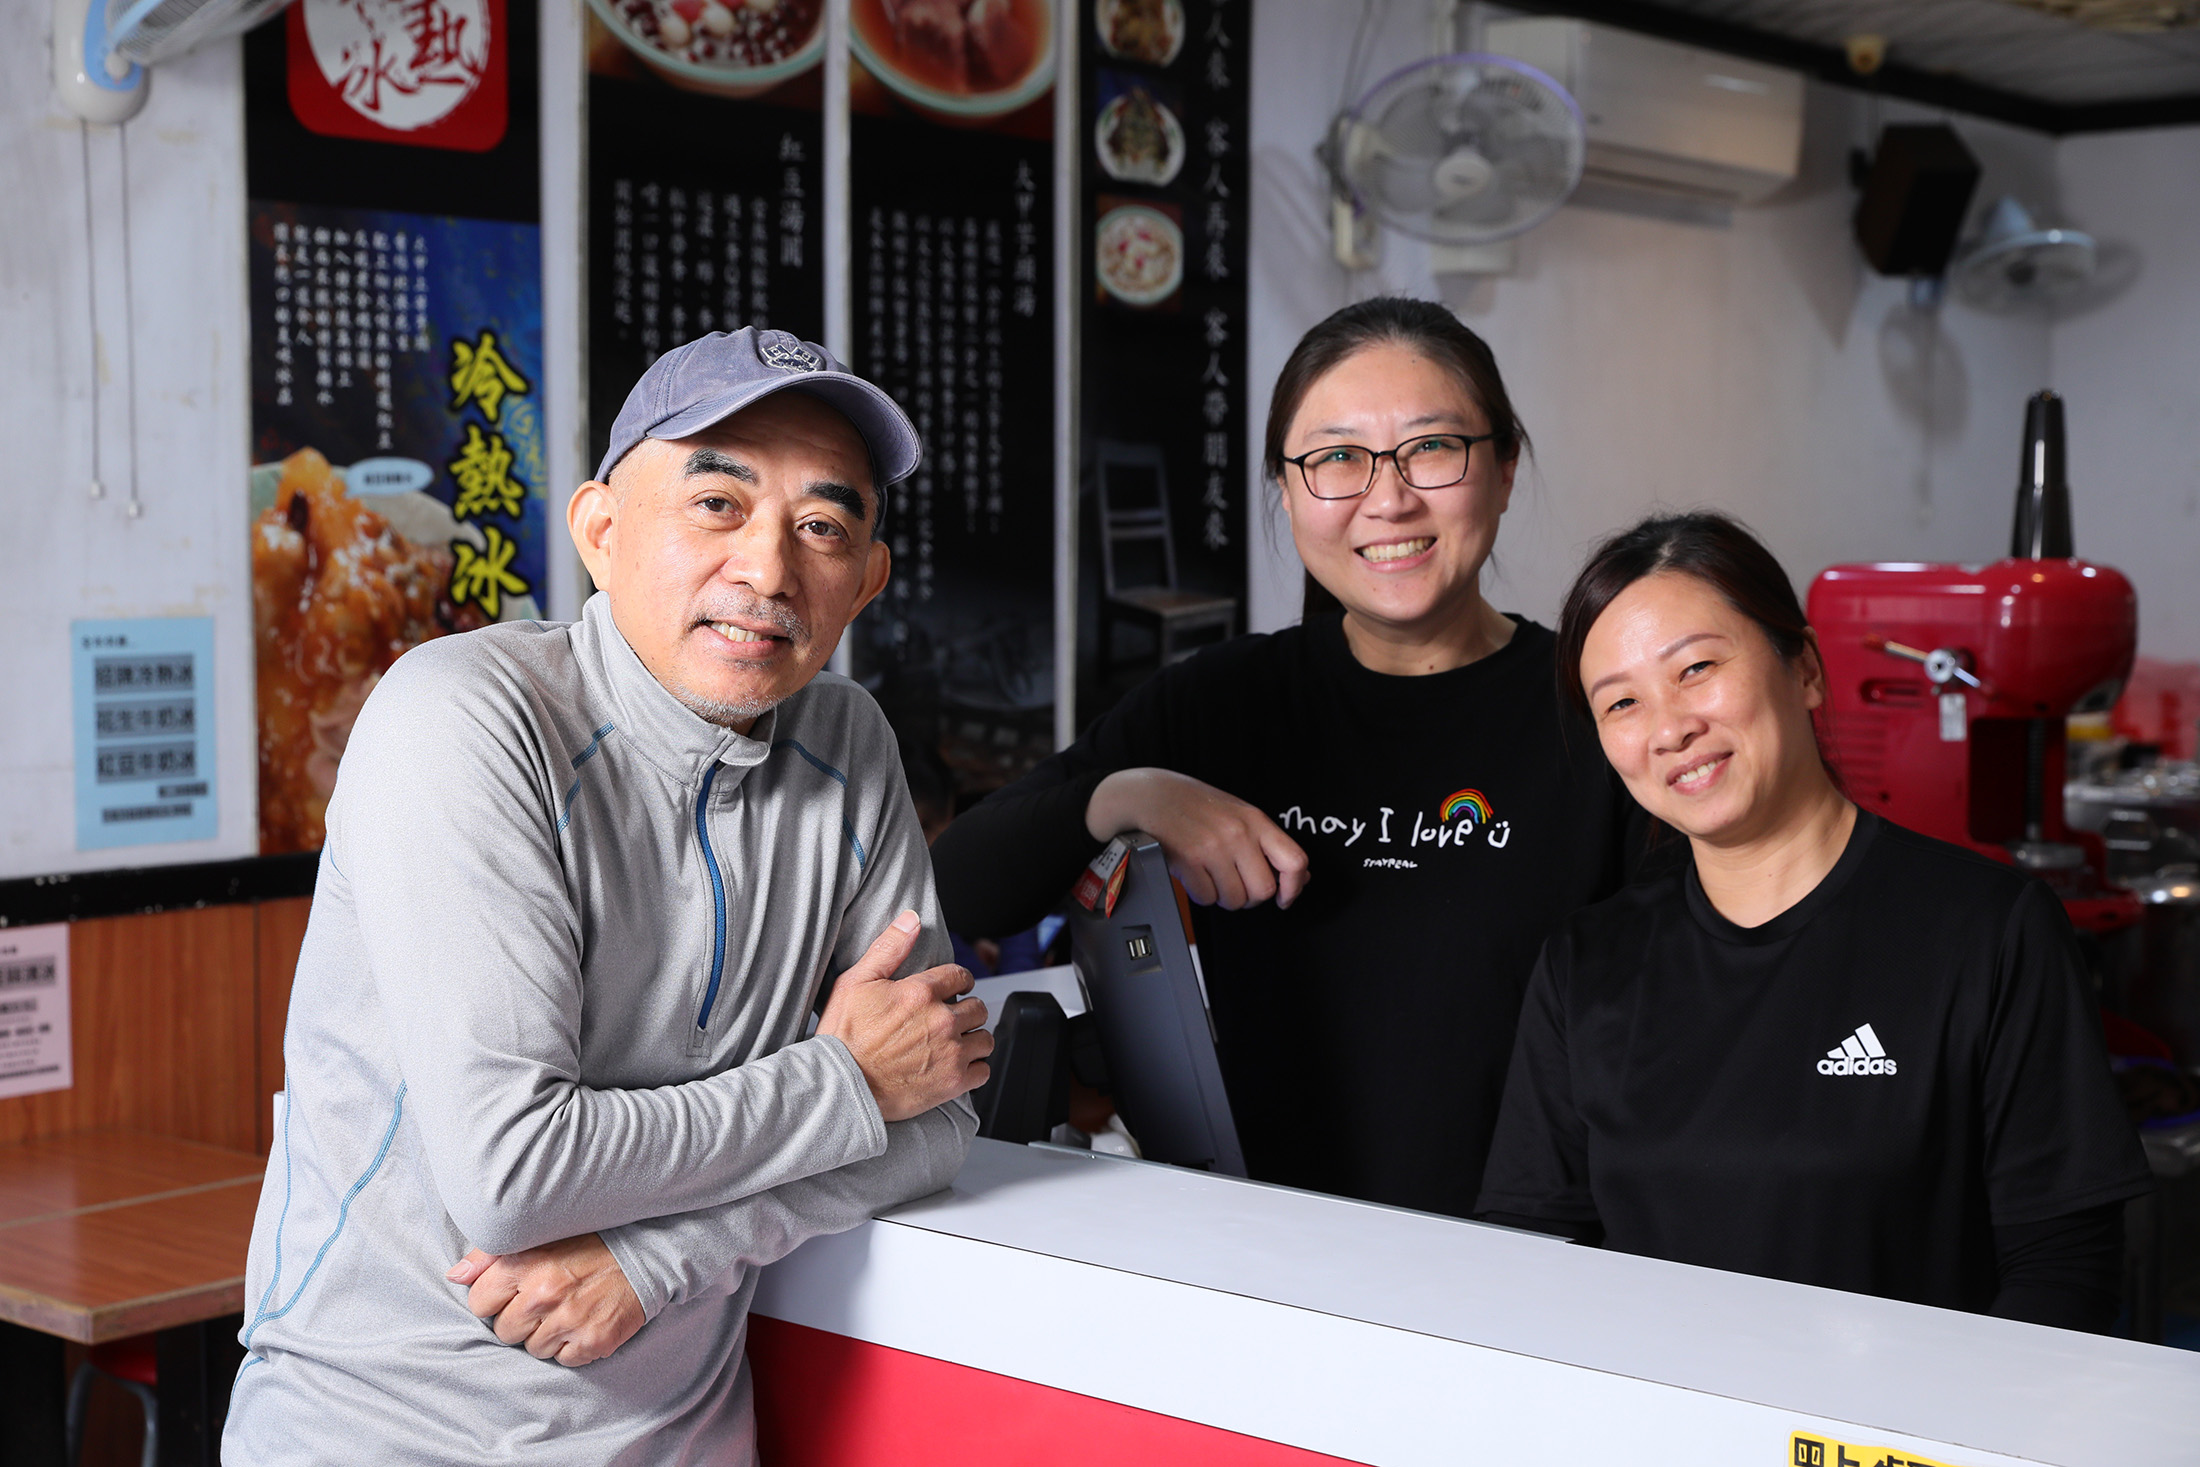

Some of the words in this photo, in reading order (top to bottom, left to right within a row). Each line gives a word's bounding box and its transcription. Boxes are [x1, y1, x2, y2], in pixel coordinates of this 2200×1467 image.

[450, 331, 530, 620] 冷熱冰
[1278, 805, 1367, 848] may
[1377, 806, 1395, 844] I
[1410, 810, 1475, 849] love
[1816, 1056, 1898, 1077] adidas
